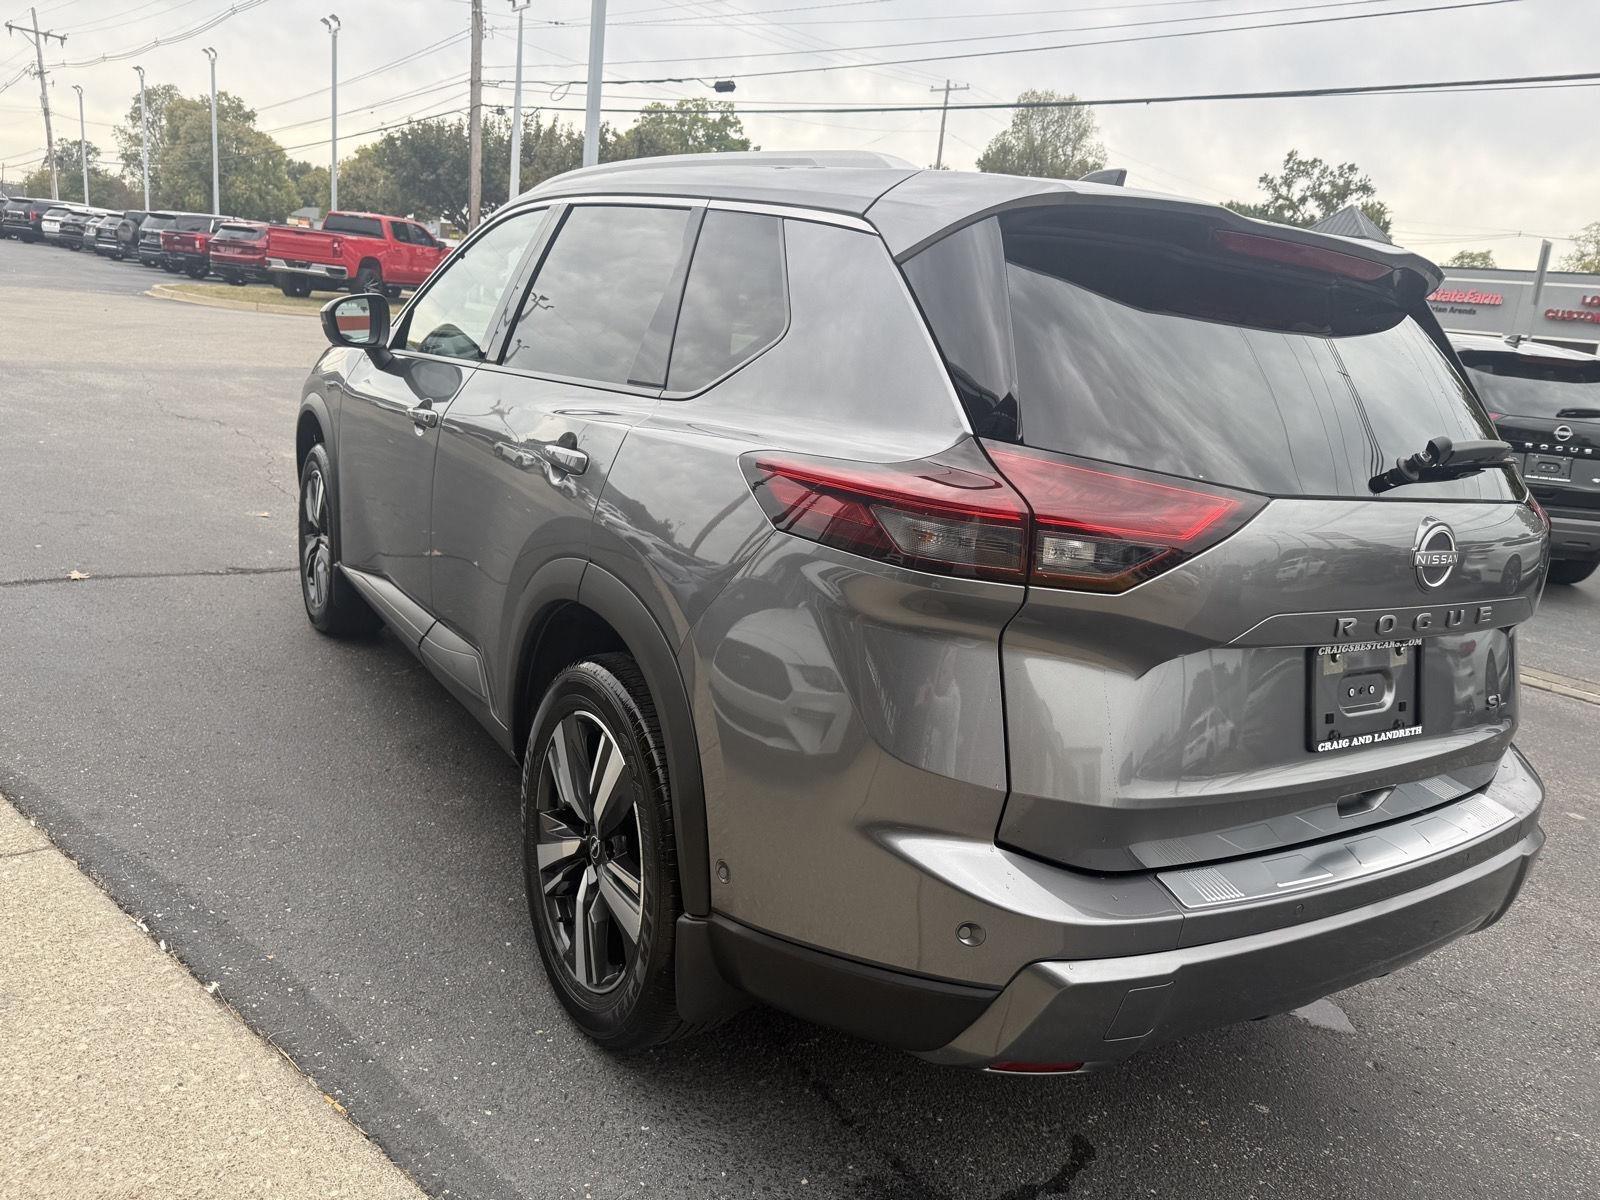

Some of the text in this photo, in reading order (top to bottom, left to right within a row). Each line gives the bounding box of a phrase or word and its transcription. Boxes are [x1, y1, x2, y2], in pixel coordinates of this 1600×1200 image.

[1416, 551, 1459, 565] NISSAN
[1335, 606, 1493, 637] ROGUE
[1488, 694, 1507, 709] SL
[1317, 726, 1423, 752] CRAIG AND LANDRETH
